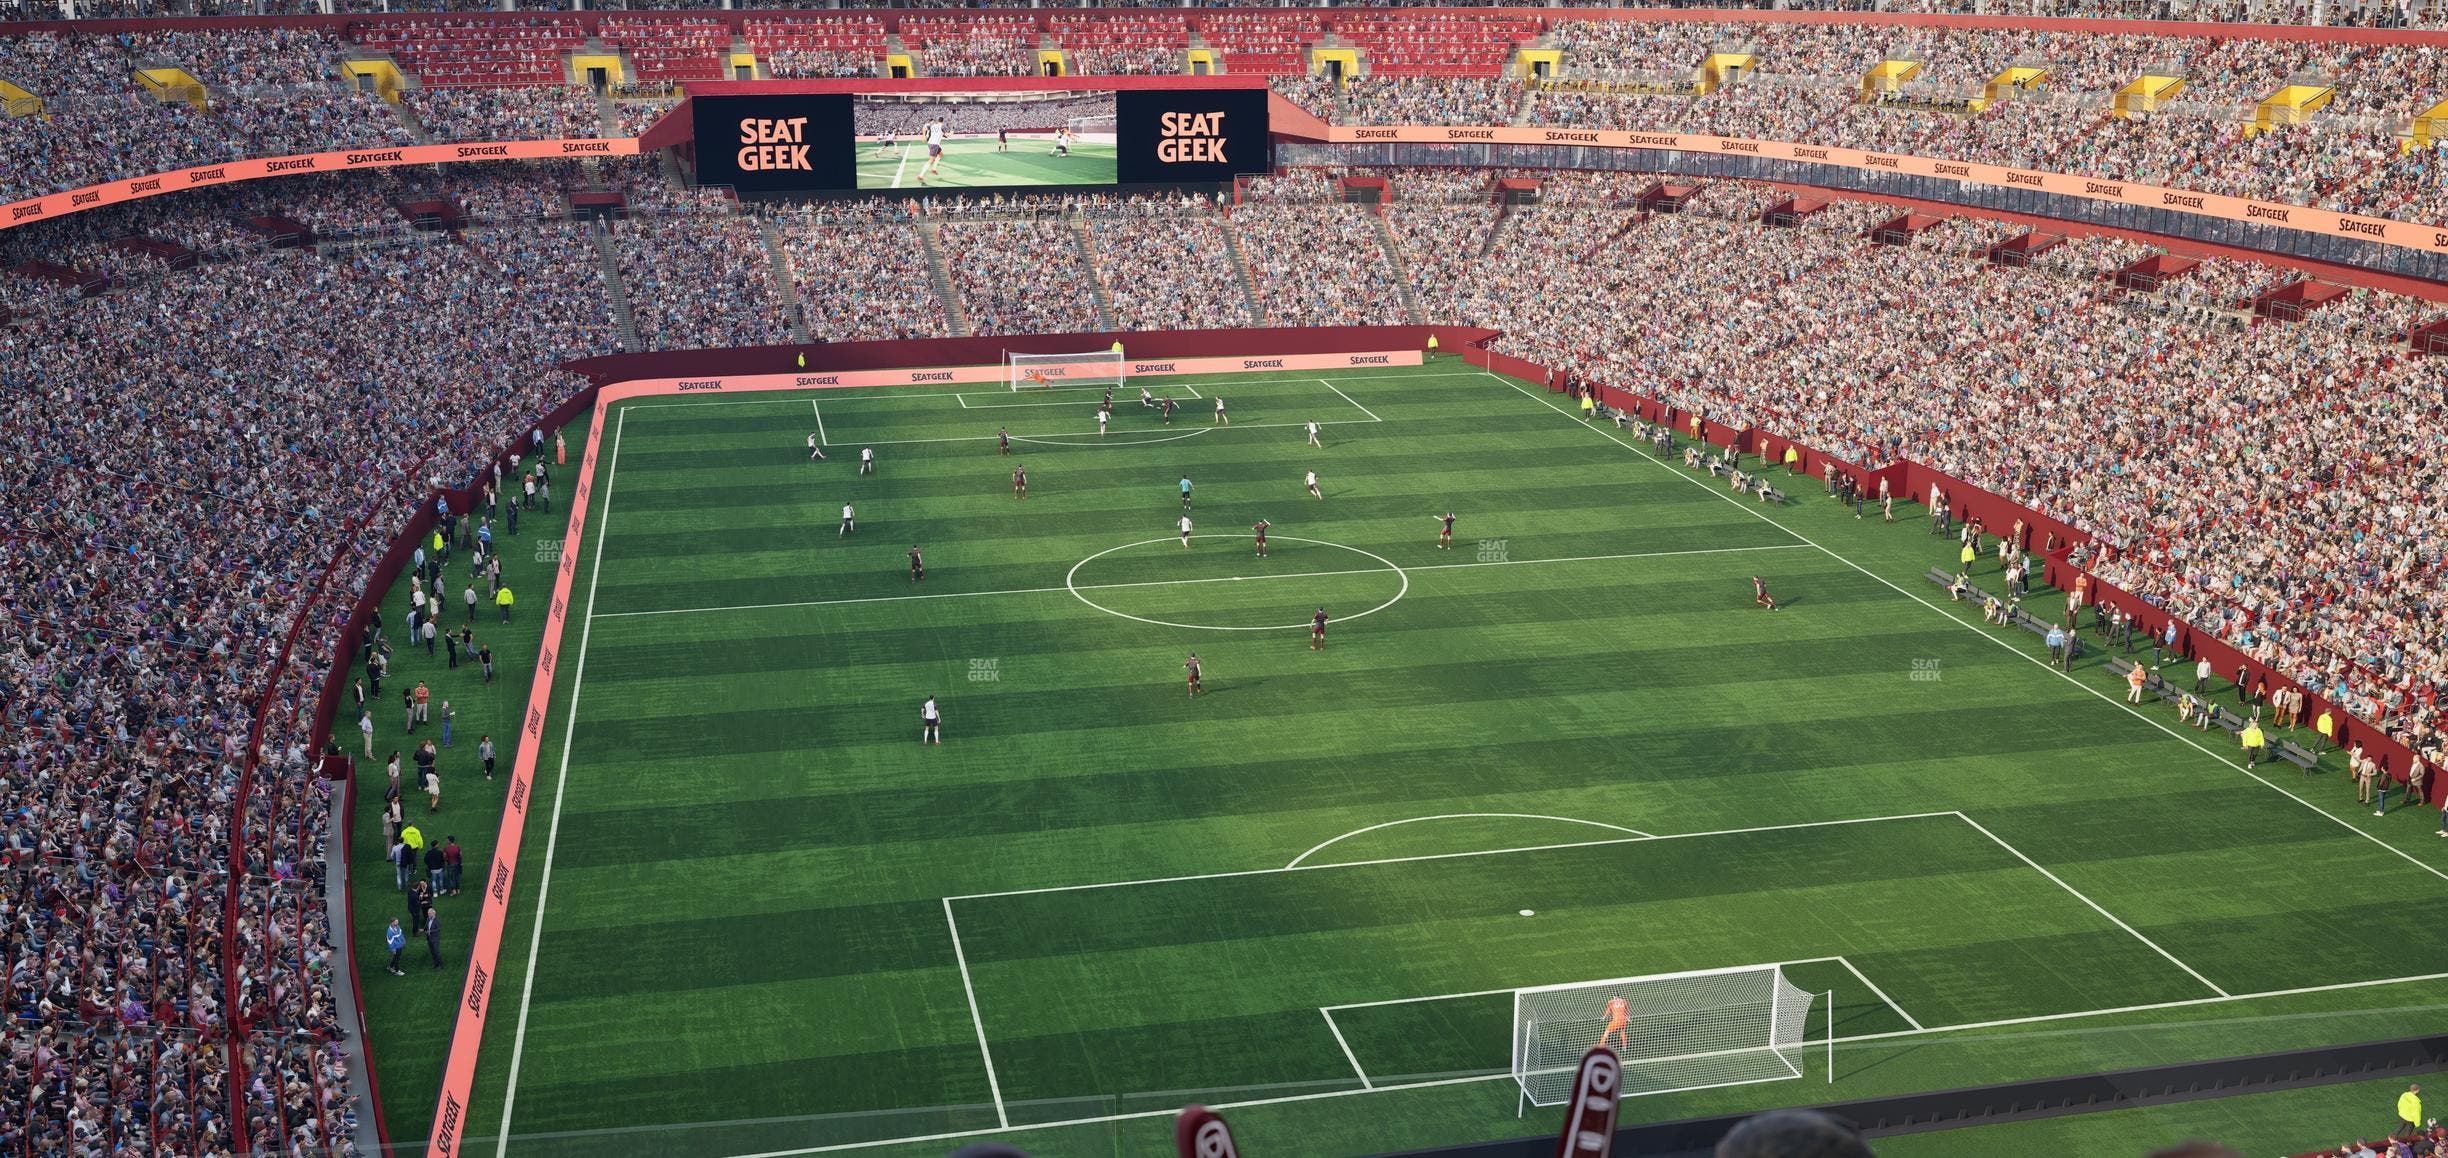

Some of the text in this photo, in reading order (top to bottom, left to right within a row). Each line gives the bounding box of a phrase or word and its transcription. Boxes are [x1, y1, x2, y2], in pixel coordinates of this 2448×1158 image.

[740, 117, 807, 144] SEAT
[1161, 111, 1225, 137] SEAT
[1356, 130, 1398, 139] SEATGEEK
[1449, 130, 1494, 140] SEATGEEK
[1546, 132, 1599, 143] SEATGEEK
[1630, 135, 1677, 147] SEATGEEK
[458, 146, 508, 158] SEATGEEK
[563, 142, 610, 153] SEATGEEK
[1157, 138, 1228, 163] GEEK
[1722, 141, 1759, 153] SEATGEEK
[1794, 148, 1829, 161] SEATGEEK
[267, 158, 315, 173] SEATGEEK
[347, 151, 403, 165] SEATGEEK
[738, 145, 813, 171] GEEK
[1866, 155, 1899, 169] SEATGEEK
[191, 168, 226, 184] SEATGEEK
[1935, 163, 1970, 178] SEATGEEK
[131, 178, 161, 195] SEATGEEK
[2007, 172, 2044, 188] SEATGEEK
[2086, 182, 2123, 198] SEATGEEK
[72, 191, 100, 207] SEATGEEK
[2164, 193, 2204, 210] SEATGEEK
[13, 203, 43, 221] SEATGEEK
[2247, 205, 2290, 223] SEATGEEK
[2339, 219, 2386, 238] SEATGEEK
[1135, 363, 1176, 374] SEATGEEK
[1243, 359, 1284, 369] SEATGEEK
[796, 375, 839, 387] SEATGEEK
[911, 371, 954, 382] SEATGEEK
[678, 380, 722, 391] SEATGEEK
[468, 960, 488, 1018] SEATGEEK
[436, 1090, 461, 1158] SEATGEEK
